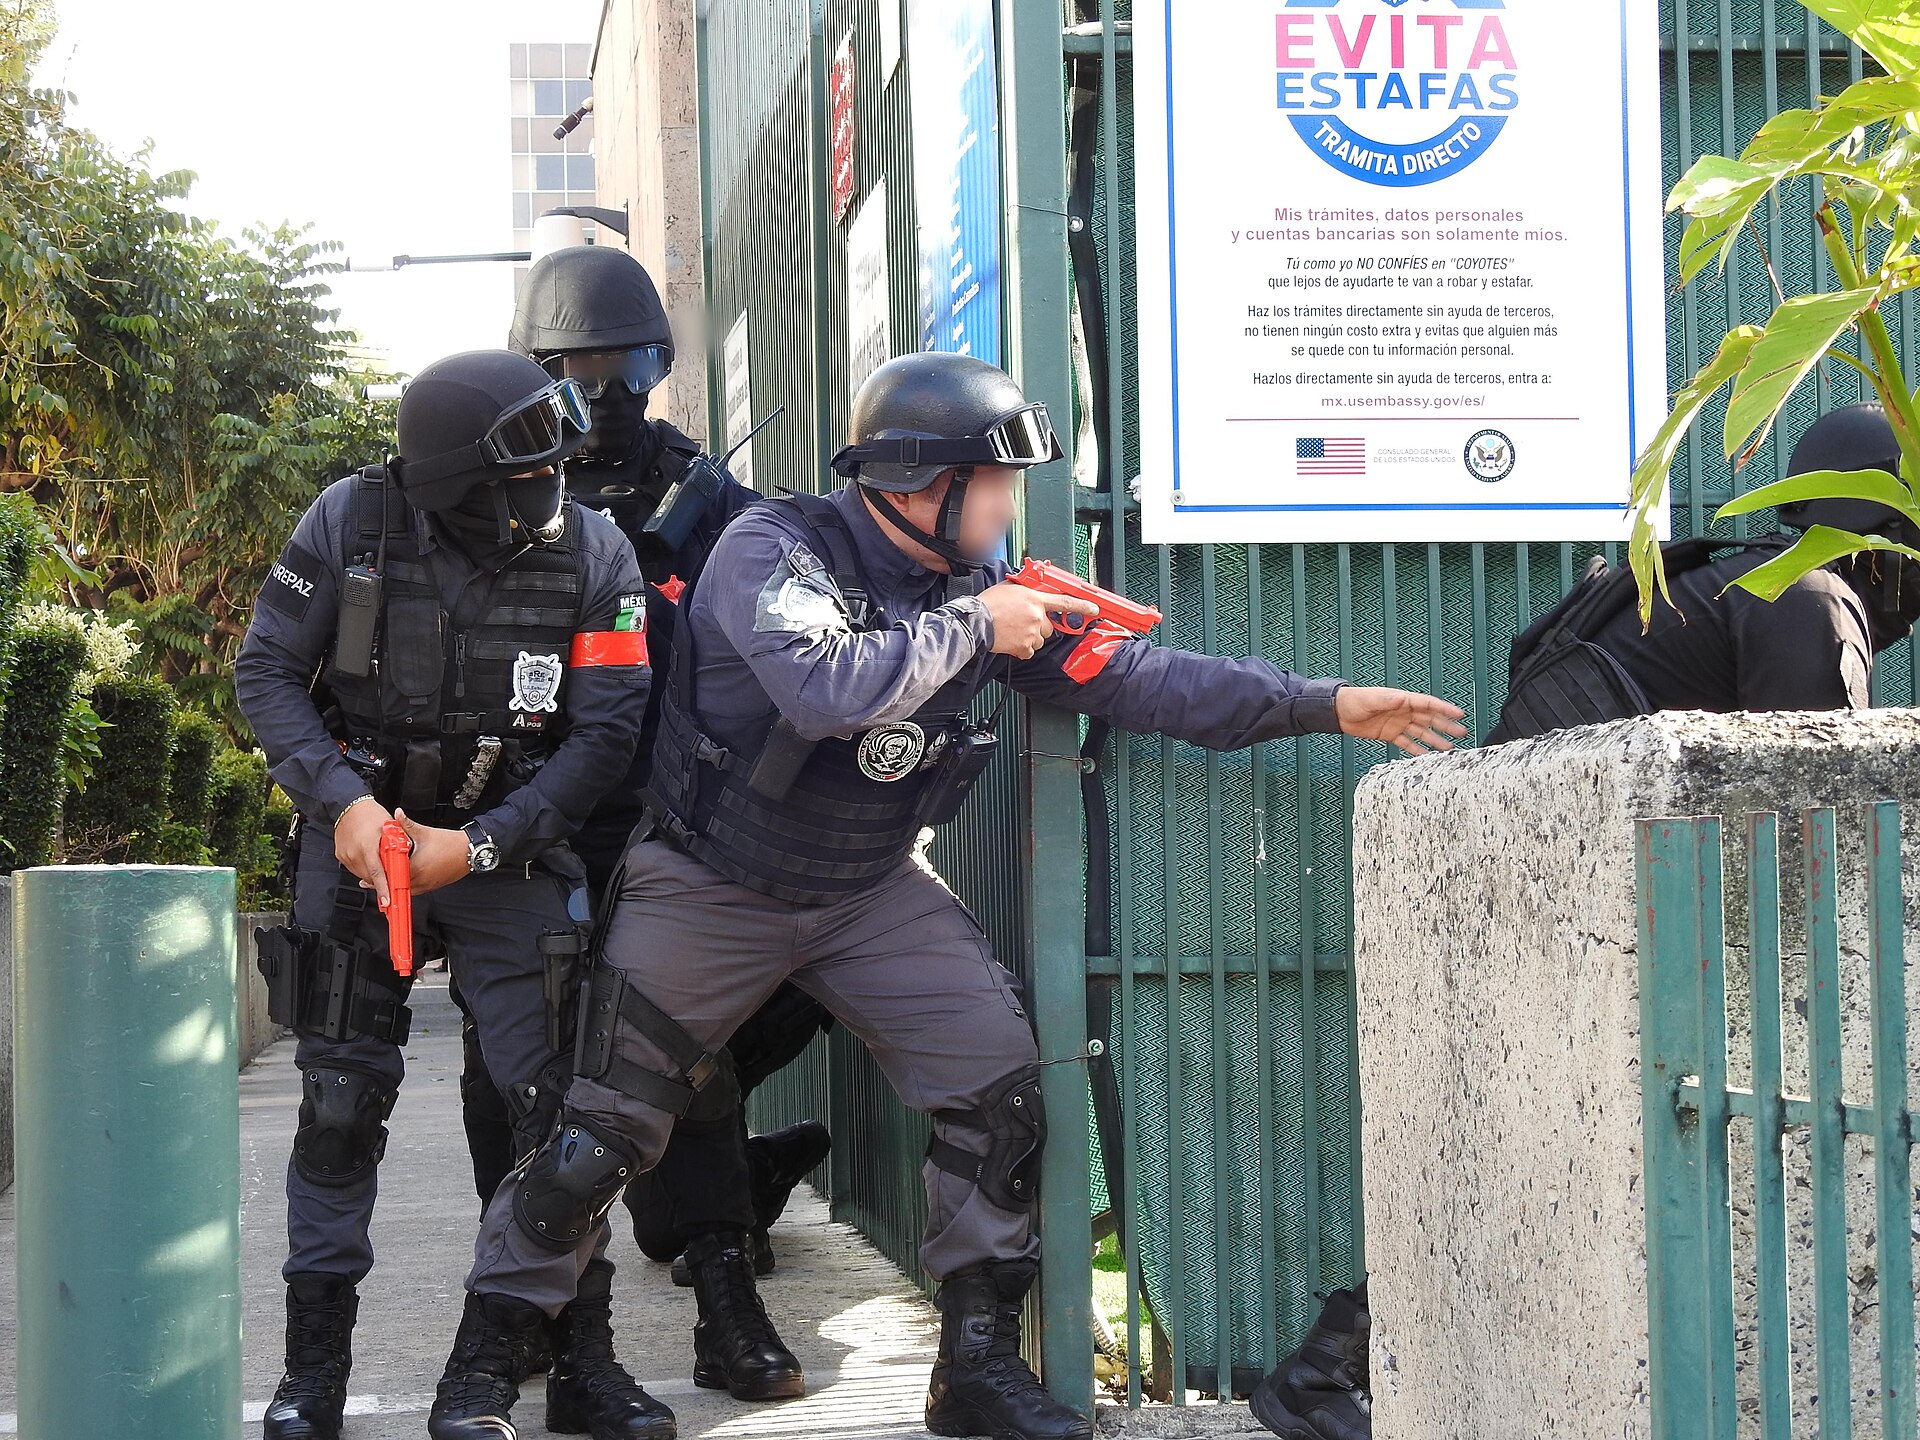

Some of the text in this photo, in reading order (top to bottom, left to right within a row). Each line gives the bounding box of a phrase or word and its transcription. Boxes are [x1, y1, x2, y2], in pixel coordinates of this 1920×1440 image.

[1276, 14, 1518, 70] EVITA
[1277, 72, 1519, 110] ESTAFAS
[1313, 119, 1482, 176] TRAMITA DIRECTO
[1275, 207, 1524, 225] Mis trámites, datos personales
[1231, 226, 1568, 243] y cuentas bancarias son solamente míos.
[1286, 254, 1515, 273] Tú como yo NO CONFÍES en "COYOTES"
[1268, 274, 1534, 290] que lejos de ayudarte te van a robar y estafar.
[1247, 304, 1554, 320] Haz los trámites directamente sin ayuda de terceros,
[1244, 323, 1558, 340] no tienen ningún costo extra y evitas que alguien más
[1291, 343, 1514, 359] se quede con tu información personal.
[1253, 371, 1552, 387] Hazlos directamente sin ayuda de terceros, entra a:
[1321, 395, 1485, 409] mx.usembassy.gov/es/
[1377, 448, 1452, 456] CONSULADO GENERAL
[512, 713, 526, 728] A
